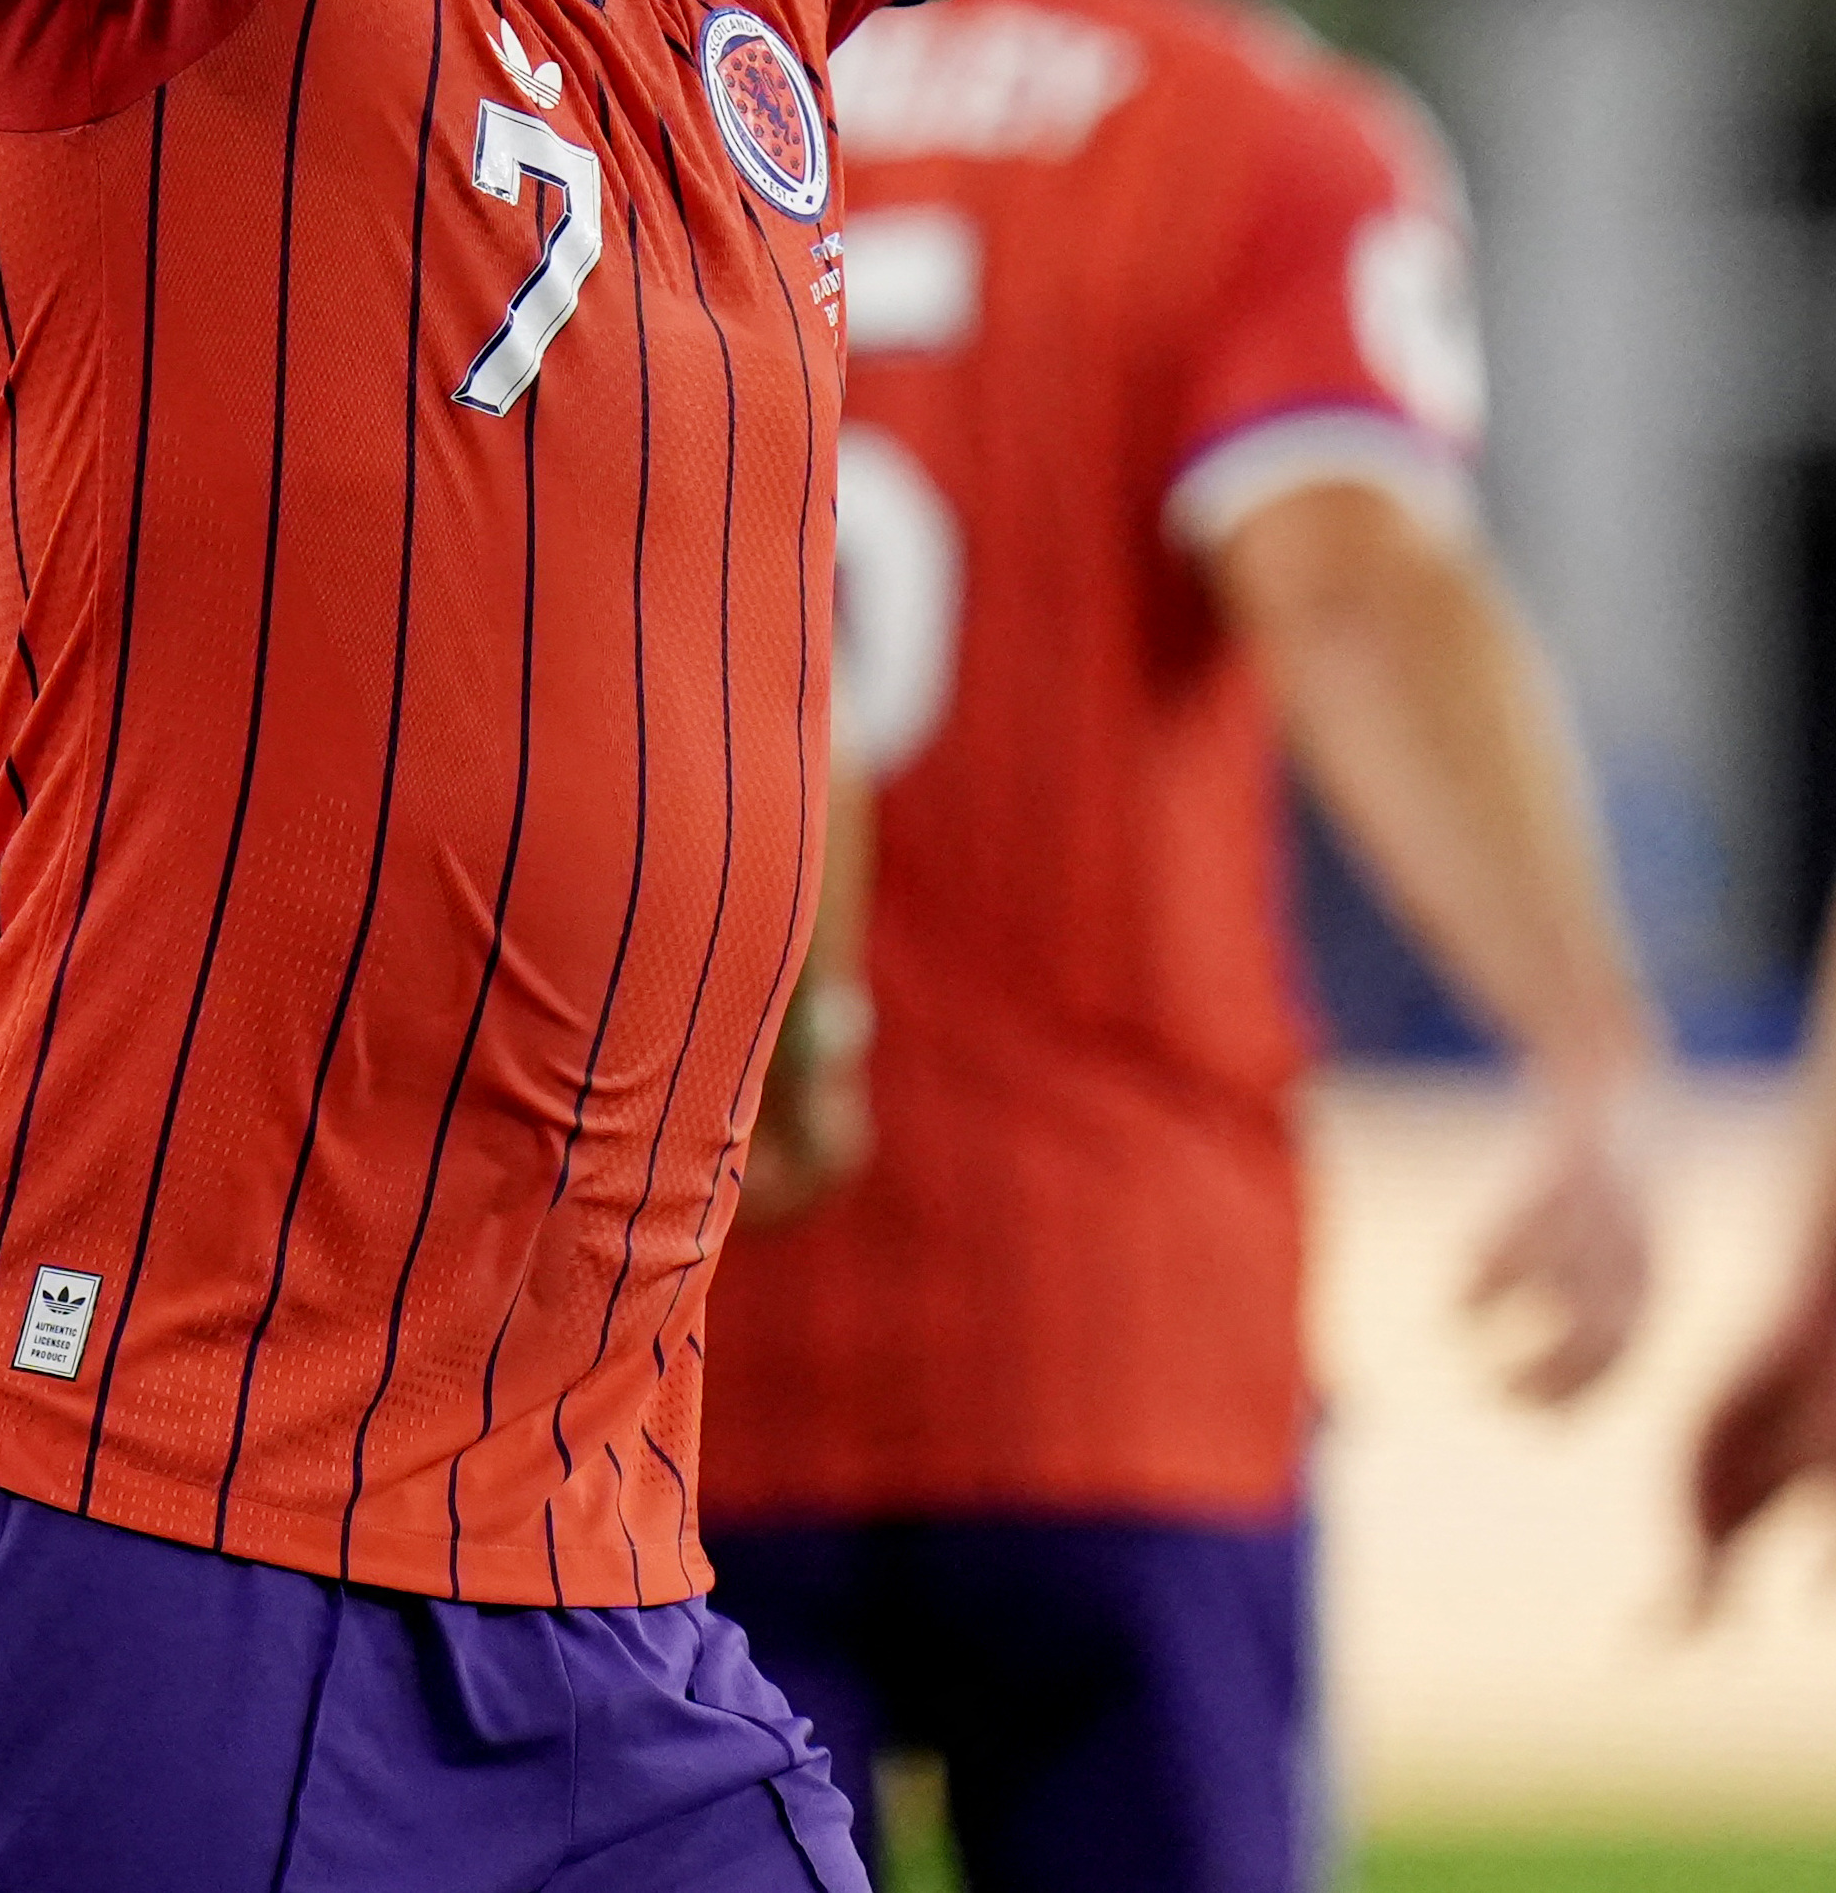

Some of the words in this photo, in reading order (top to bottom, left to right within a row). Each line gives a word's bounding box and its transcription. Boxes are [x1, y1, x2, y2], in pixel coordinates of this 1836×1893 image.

[710, 18, 754, 56] SCOTLAND
[770, 181, 787, 202] EST
[450, 98, 602, 417] 7
[35, 1321, 78, 1337] AUTHENTIC
[33, 1336, 71, 1349] LICENSED
[30, 1349, 67, 1363] PRODUCT
